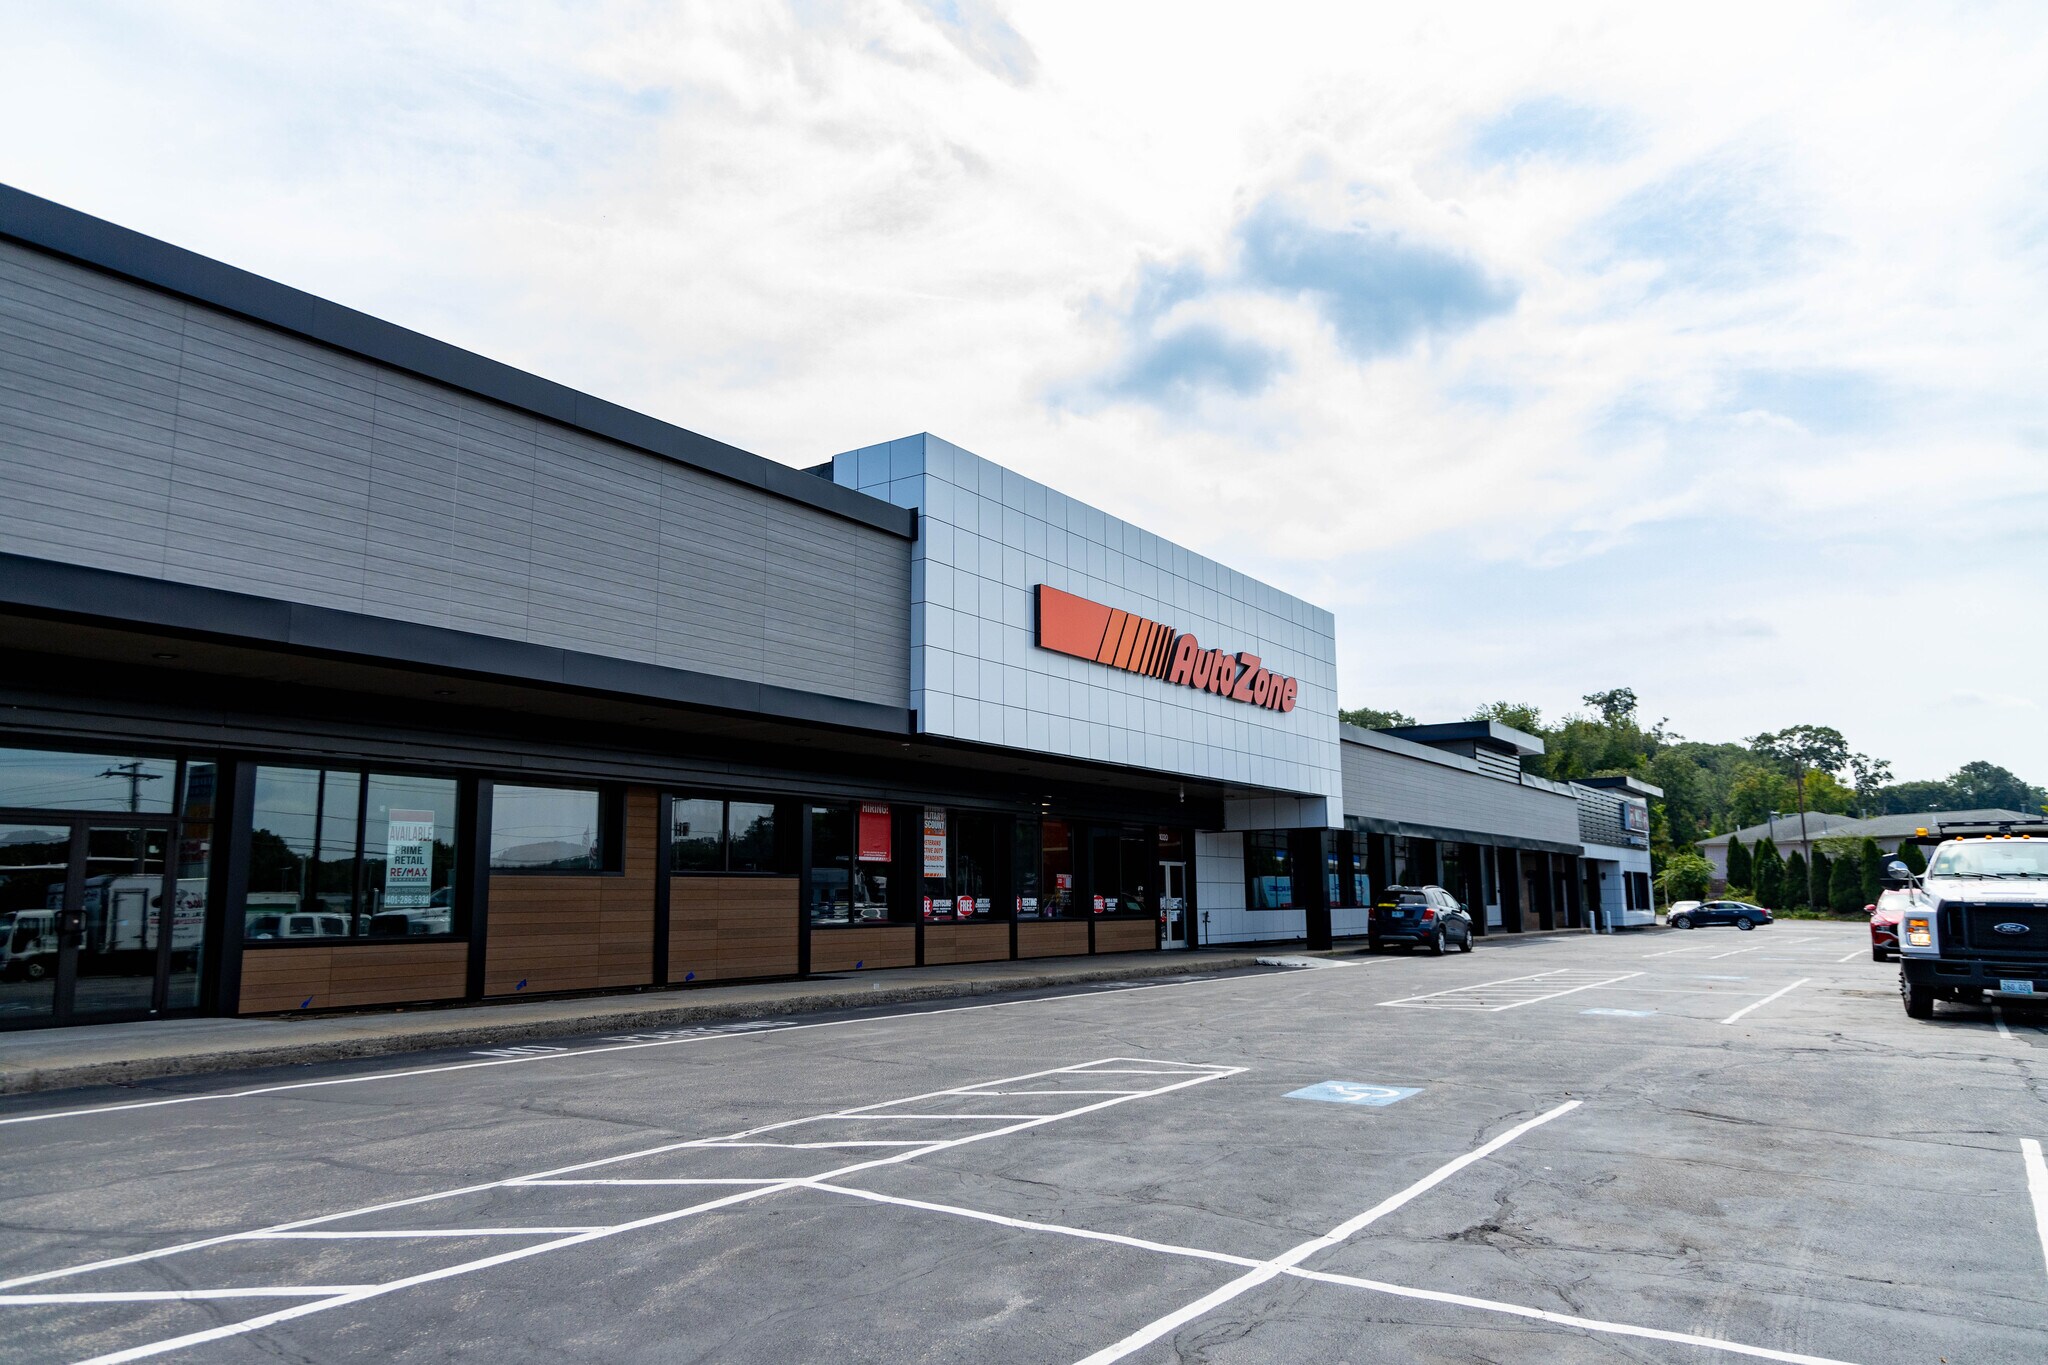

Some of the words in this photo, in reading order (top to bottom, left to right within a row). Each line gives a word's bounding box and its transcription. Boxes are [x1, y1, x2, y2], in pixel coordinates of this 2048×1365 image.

[1165, 633, 1298, 713] AutoZone
[390, 825, 432, 841] AVAILABLE
[395, 845, 423, 855] PRIME
[394, 856, 425, 865] RETAIL
[390, 867, 428, 877] RE/MAX
[960, 900, 973, 912] FREE
